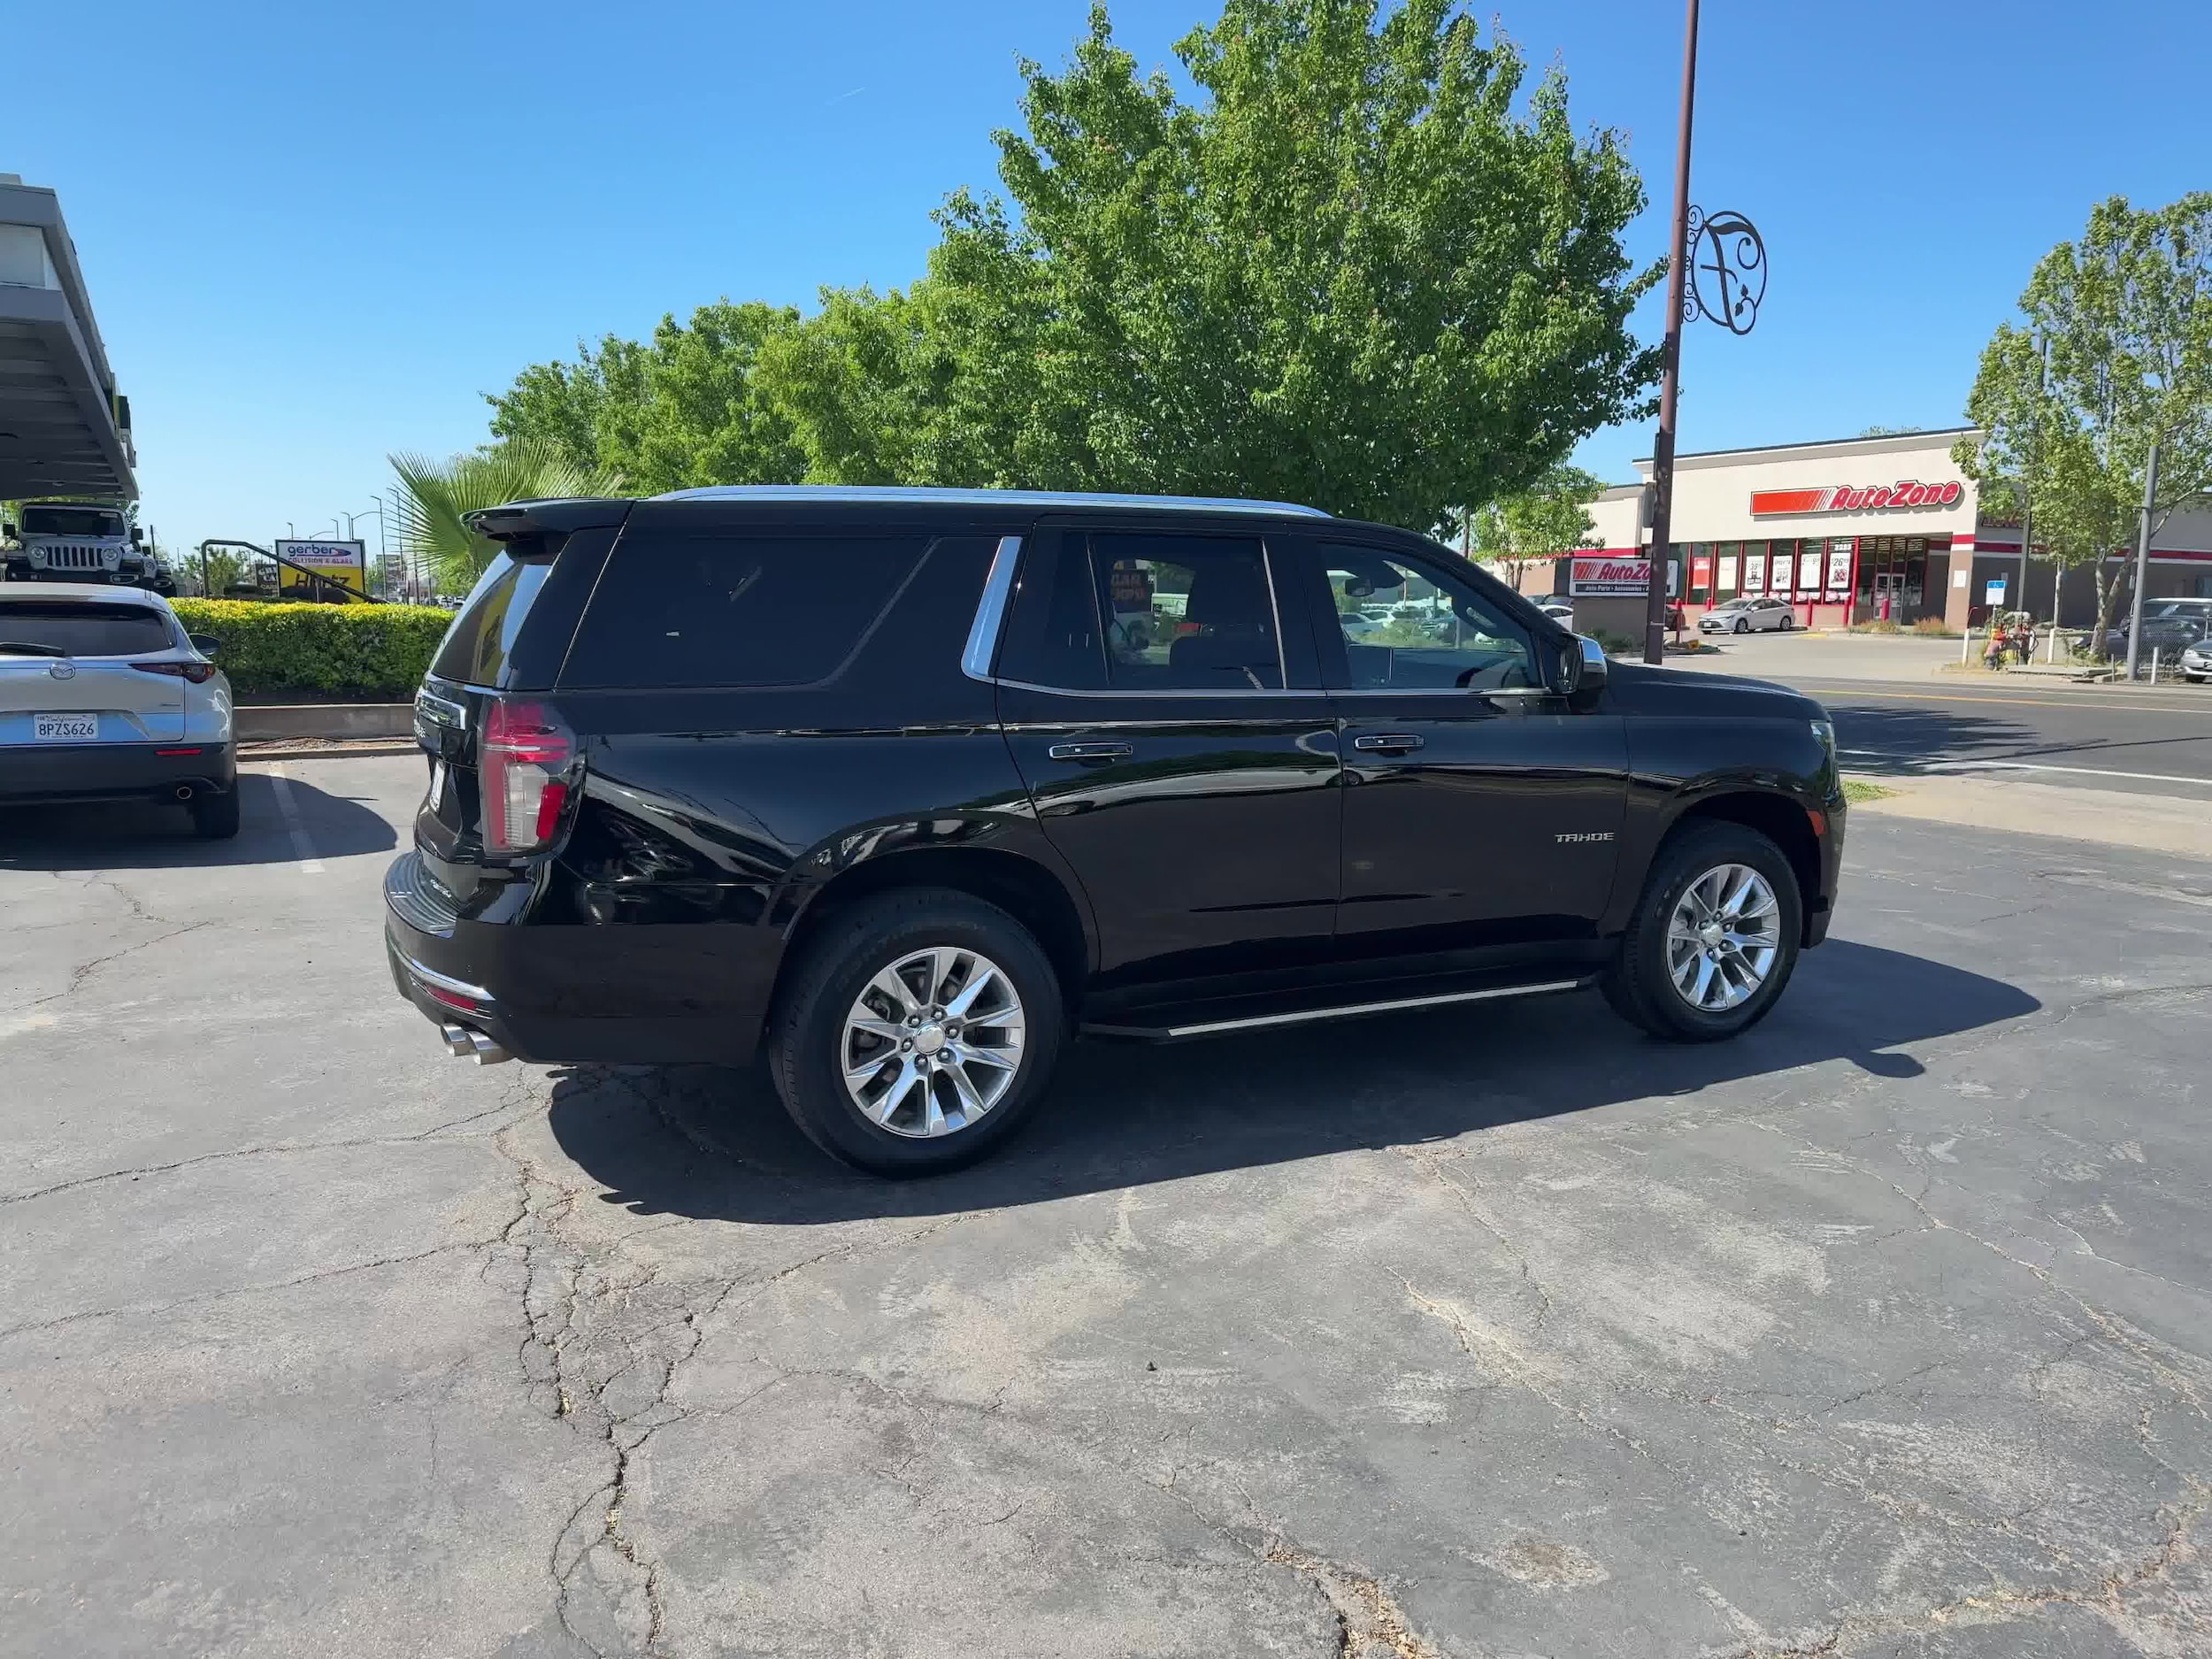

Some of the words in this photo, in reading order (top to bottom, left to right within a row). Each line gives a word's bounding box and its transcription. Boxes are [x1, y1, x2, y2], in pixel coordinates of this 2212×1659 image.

[1828, 481, 1961, 511] AutoZone
[288, 544, 335, 557] gerber
[1597, 563, 1650, 580] AutoZo
[39, 723, 95, 736] 8PZS626
[1555, 832, 1615, 843] TAHOE
